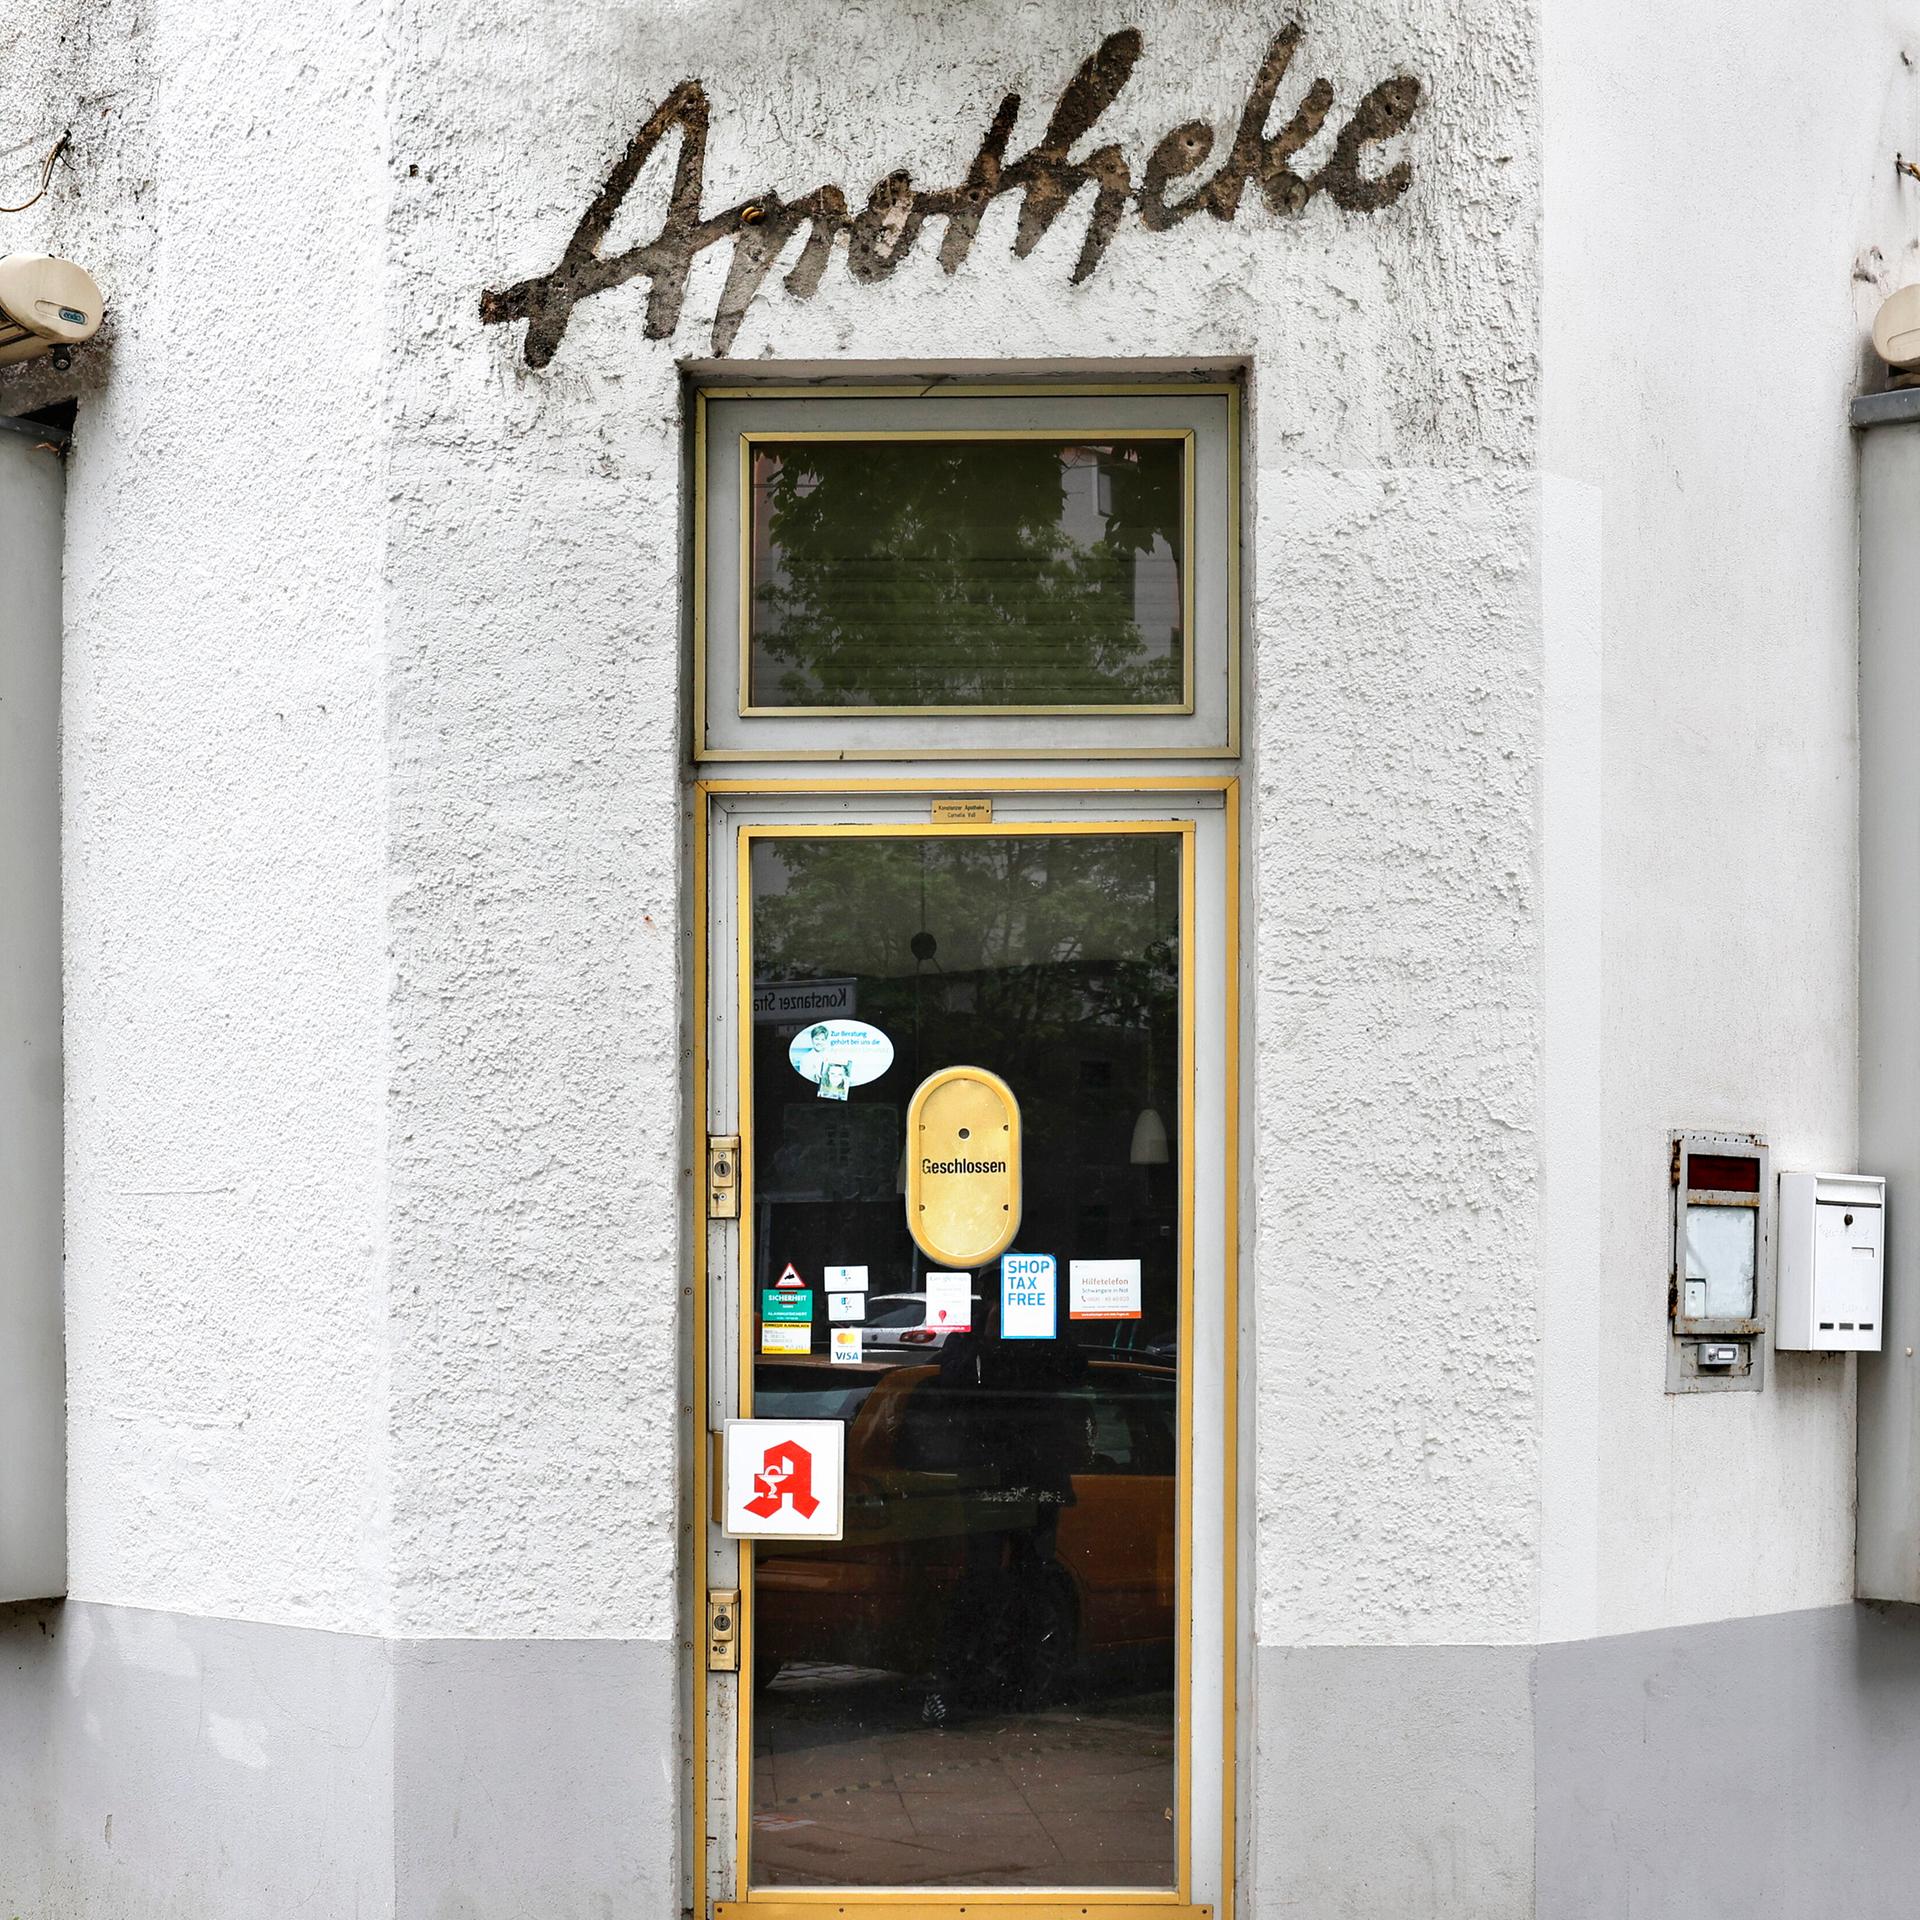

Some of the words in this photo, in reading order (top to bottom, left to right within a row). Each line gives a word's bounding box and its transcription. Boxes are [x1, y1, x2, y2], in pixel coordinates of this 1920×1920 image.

[478, 24, 1423, 370] Apotheke
[922, 1158, 1007, 1174] Geschlossen
[1007, 1260, 1050, 1274] SHOP
[1007, 1276, 1037, 1290] TAX
[1081, 1277, 1129, 1286] Hilfetelefon
[768, 1294, 808, 1302] SICHERHEIT
[1007, 1292, 1046, 1306] FREE
[835, 1351, 859, 1361] VISA
